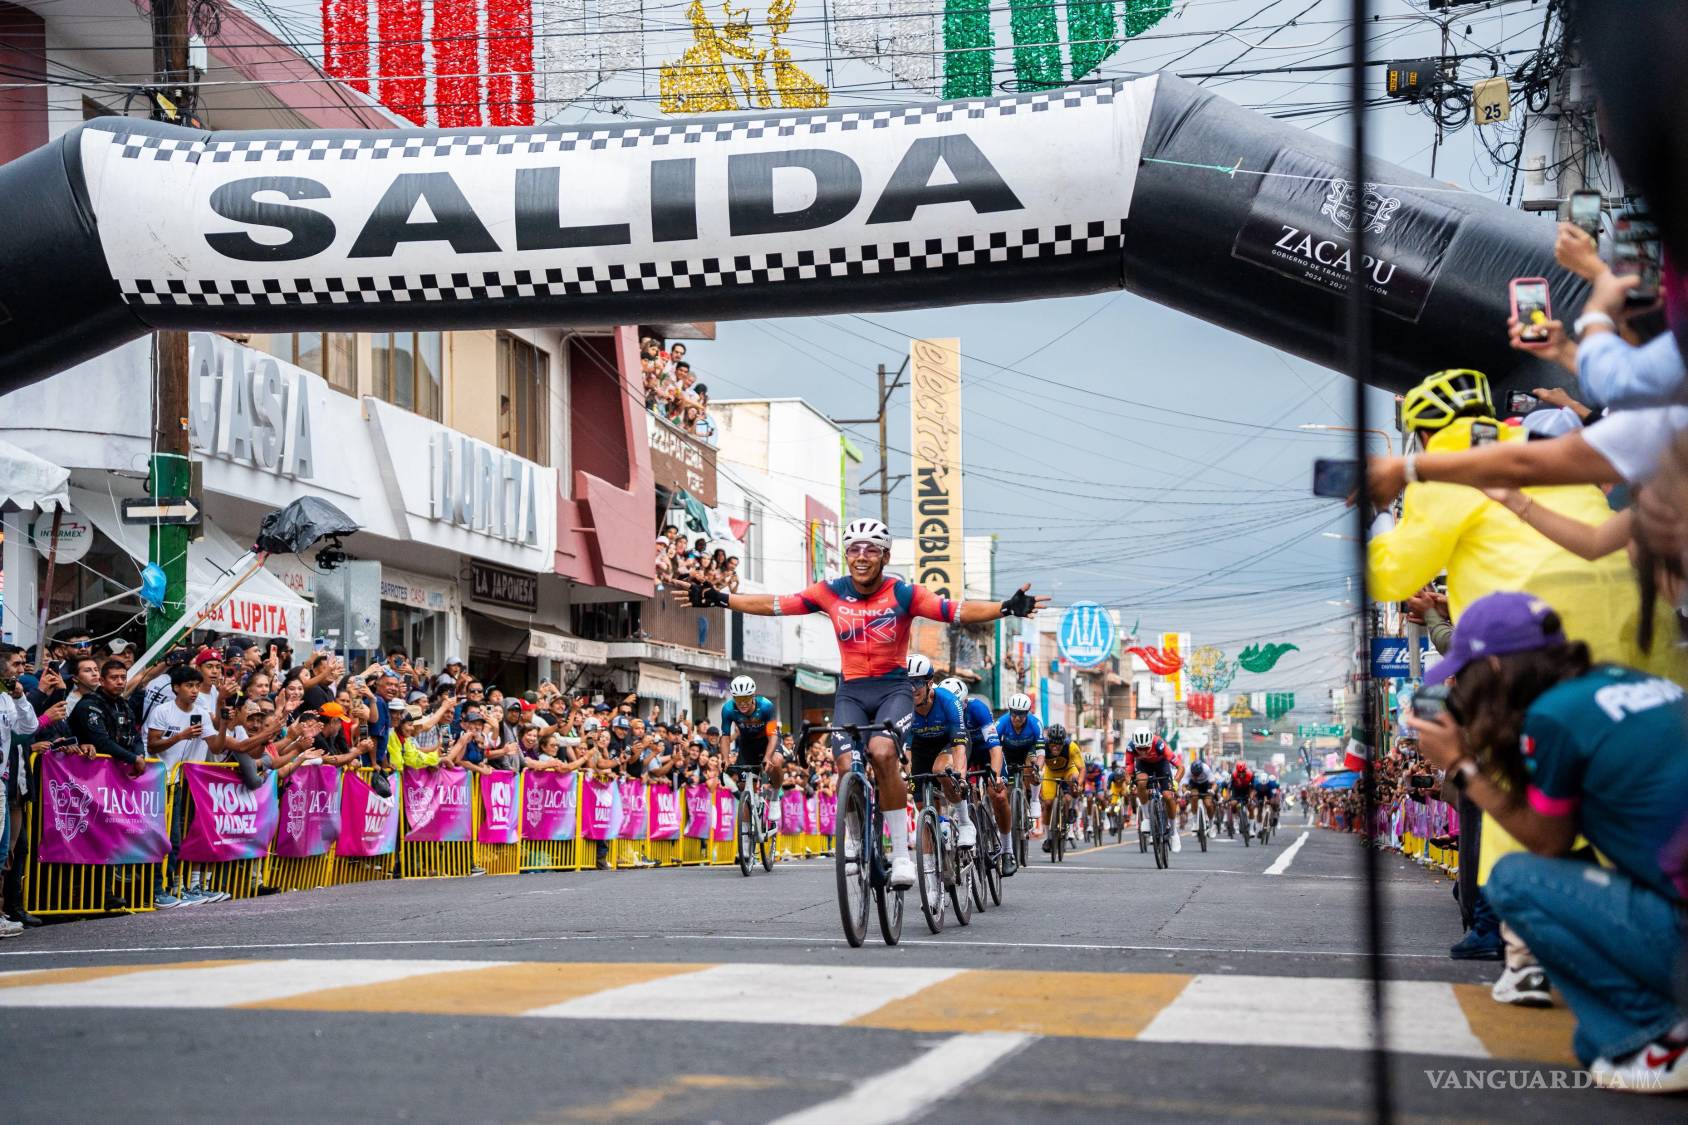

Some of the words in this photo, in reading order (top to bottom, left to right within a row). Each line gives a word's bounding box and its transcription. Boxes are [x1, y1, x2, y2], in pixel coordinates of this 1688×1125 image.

[1484, 103, 1502, 121] 25
[203, 133, 1025, 262] SALIDA
[1271, 248, 1309, 267] GOBIERNO
[1310, 263, 1321, 272] DE
[1304, 270, 1322, 281] 2024
[188, 332, 314, 480] CASA
[433, 431, 538, 546] LUPITA
[229, 599, 288, 636] LUPITA
[837, 605, 896, 617] OLINKA
[97, 786, 160, 817] ZACAPU
[214, 814, 257, 835] VALDEZ
